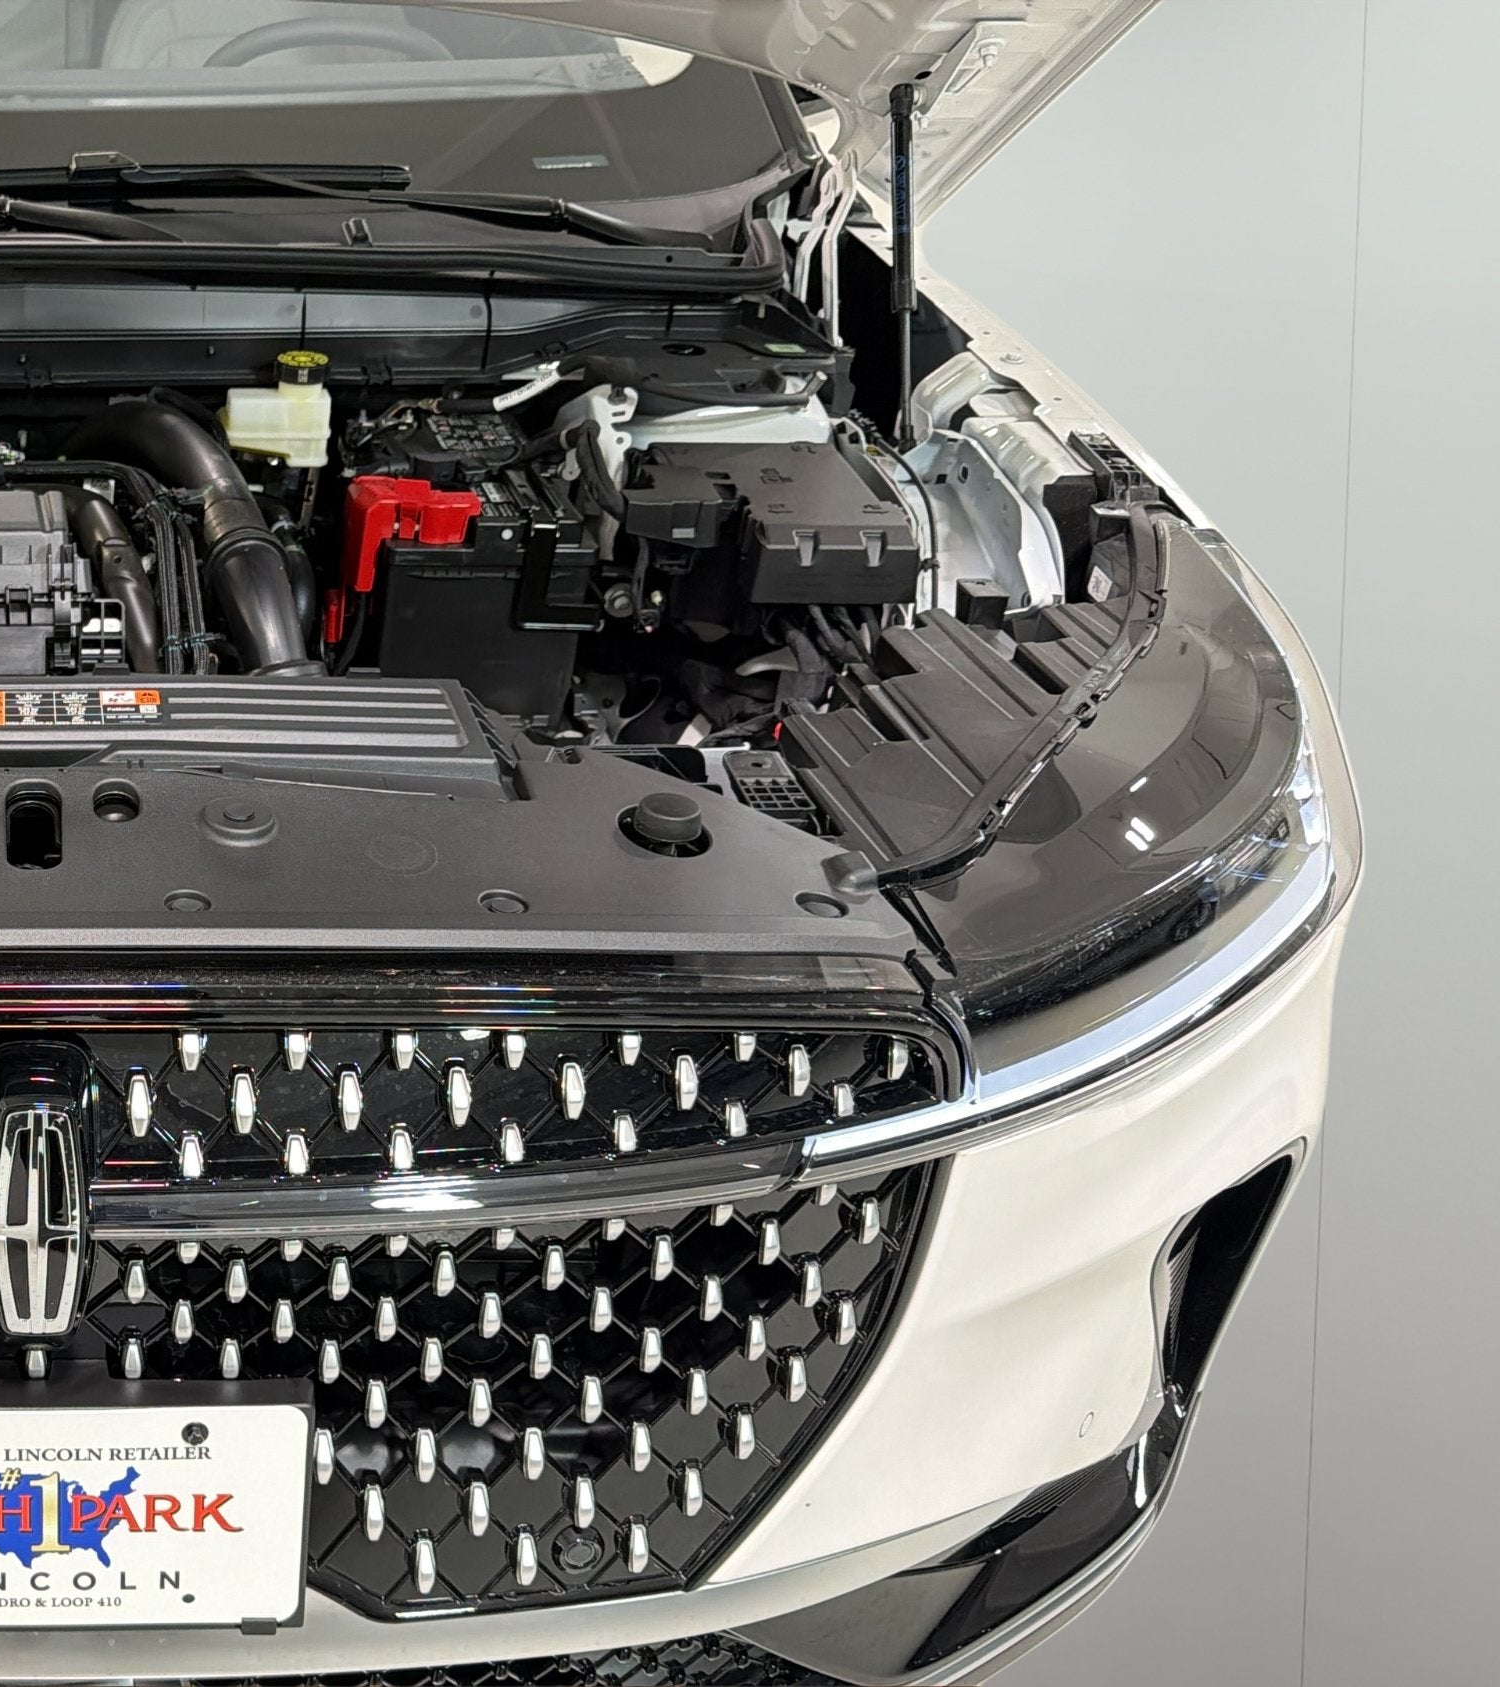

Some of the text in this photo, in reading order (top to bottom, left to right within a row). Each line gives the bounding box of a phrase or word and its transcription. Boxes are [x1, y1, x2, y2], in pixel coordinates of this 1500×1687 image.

[4, 1447, 102, 1462] LINCOLN
[108, 1446, 212, 1461] RETAILER
[69, 1494, 245, 1534] PARK
[35, 1597, 48, 1608] &
[51, 1596, 94, 1608] LOOP
[96, 1596, 122, 1608] 410
